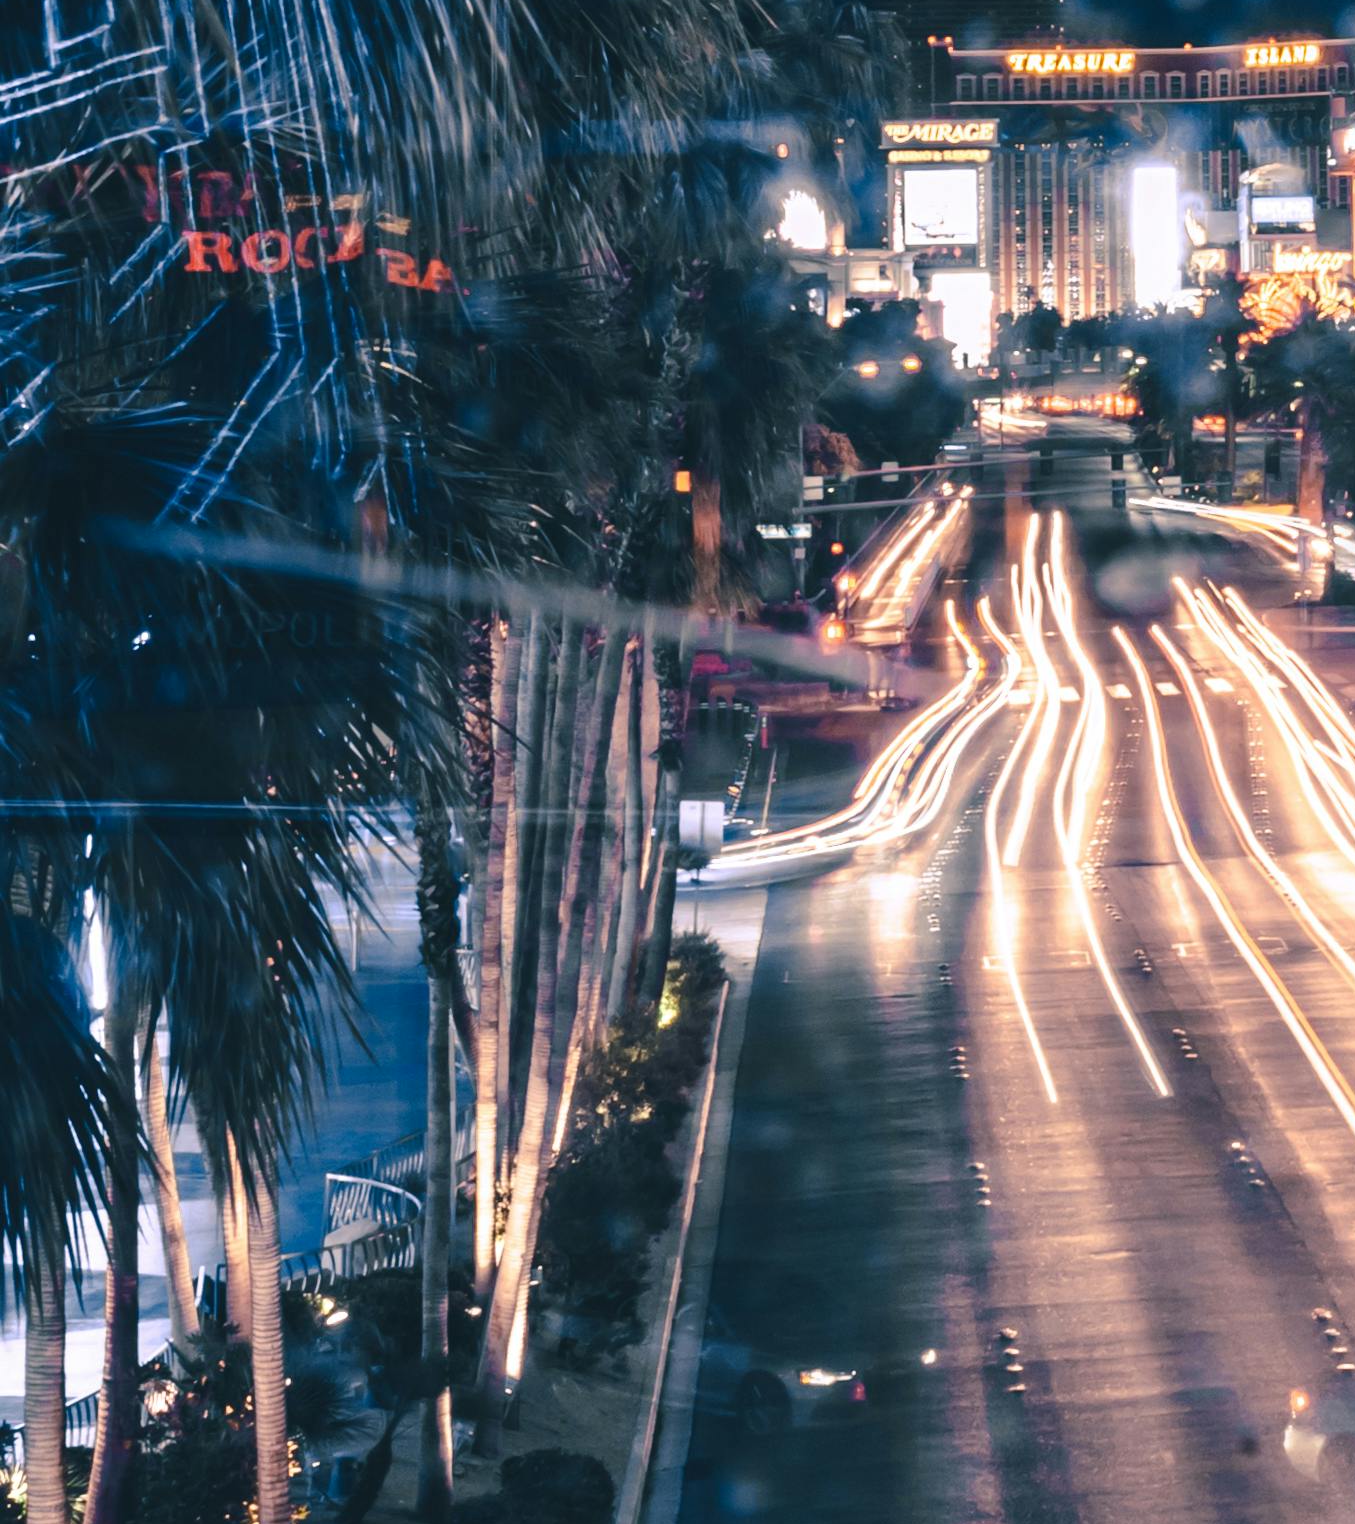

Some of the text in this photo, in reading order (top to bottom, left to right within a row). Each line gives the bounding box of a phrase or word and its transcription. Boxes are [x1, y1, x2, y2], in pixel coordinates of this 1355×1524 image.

[1009, 44, 1320, 72] TREASURE ISLAND
[894, 122, 995, 144] MIRAGE
